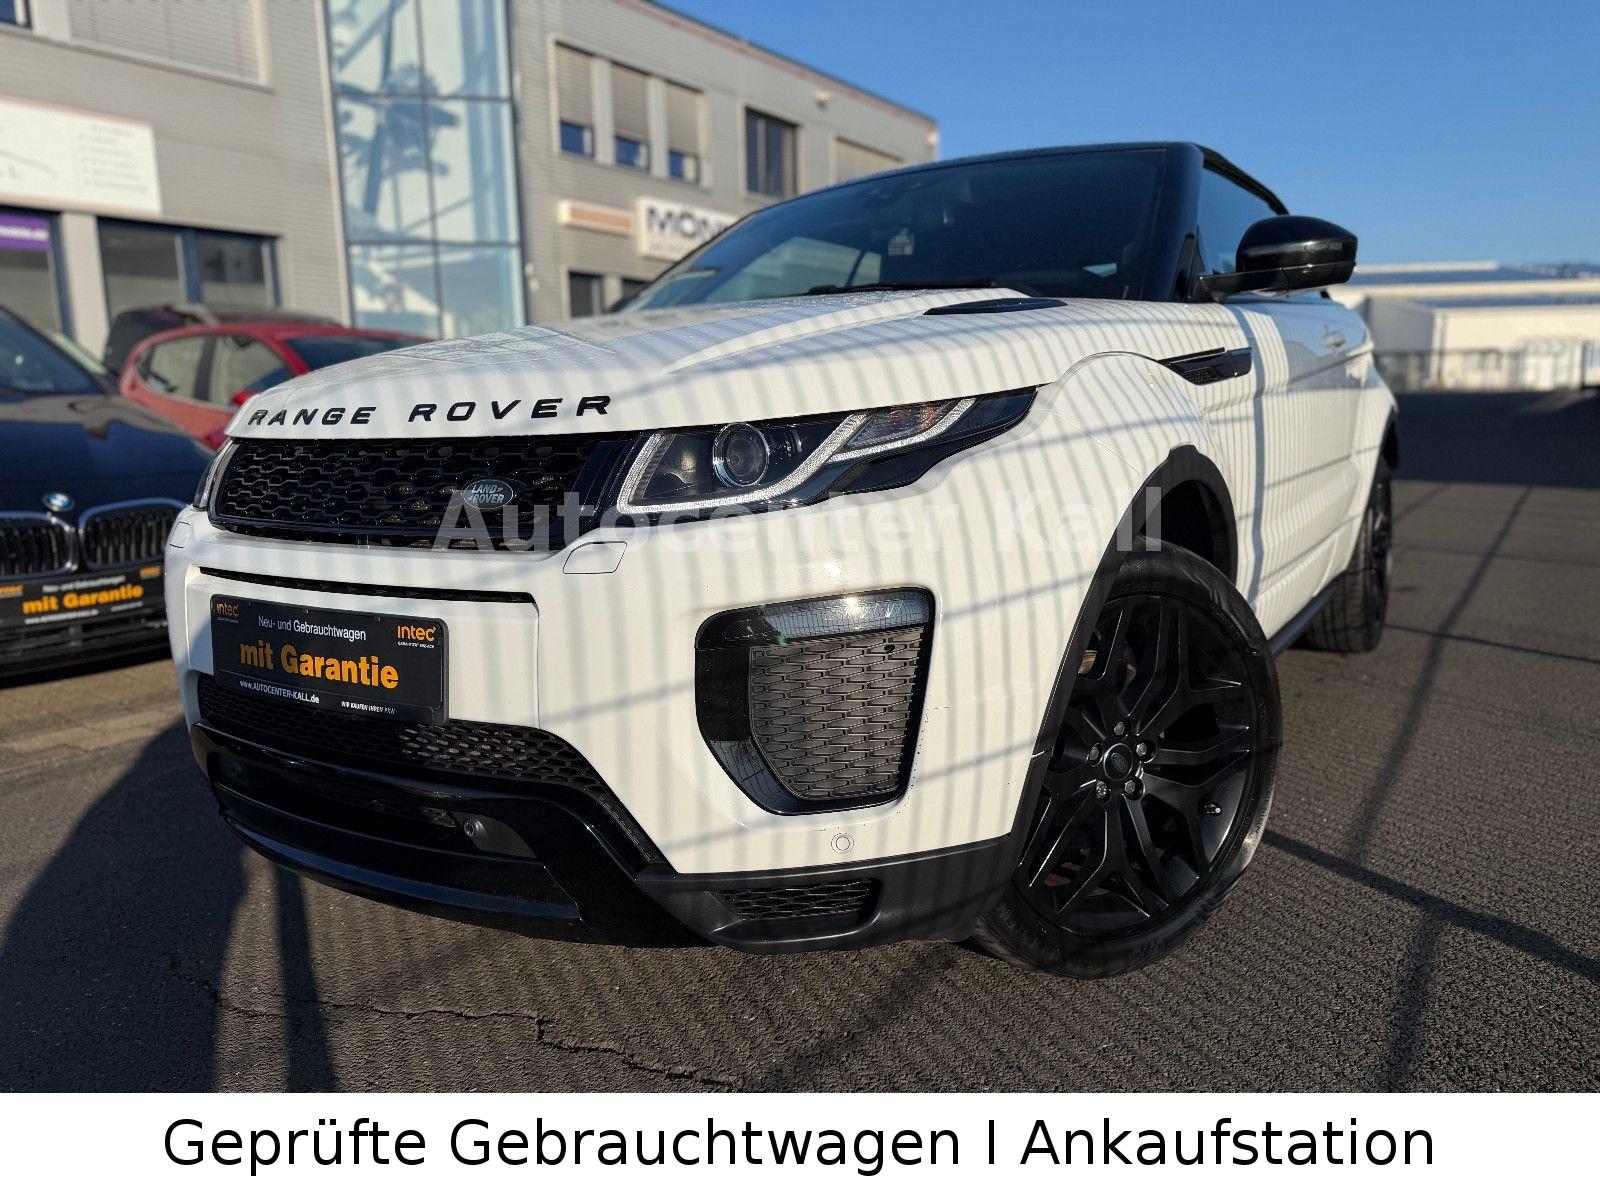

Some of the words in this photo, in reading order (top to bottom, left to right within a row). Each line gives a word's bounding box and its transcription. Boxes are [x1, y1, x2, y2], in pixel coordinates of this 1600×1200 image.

[247, 406, 377, 426] RANGE
[407, 395, 612, 422] ROVER
[471, 484, 497, 494] LAND
[472, 493, 505, 503] ROVER
[258, 615, 275, 628] Neu-
[277, 619, 292, 632] und
[293, 619, 367, 642] Gebrauchtwagen
[240, 640, 274, 670] mit
[280, 644, 399, 689] Garantie
[239, 680, 320, 704] www.AUTOCENTER-KALL.de
